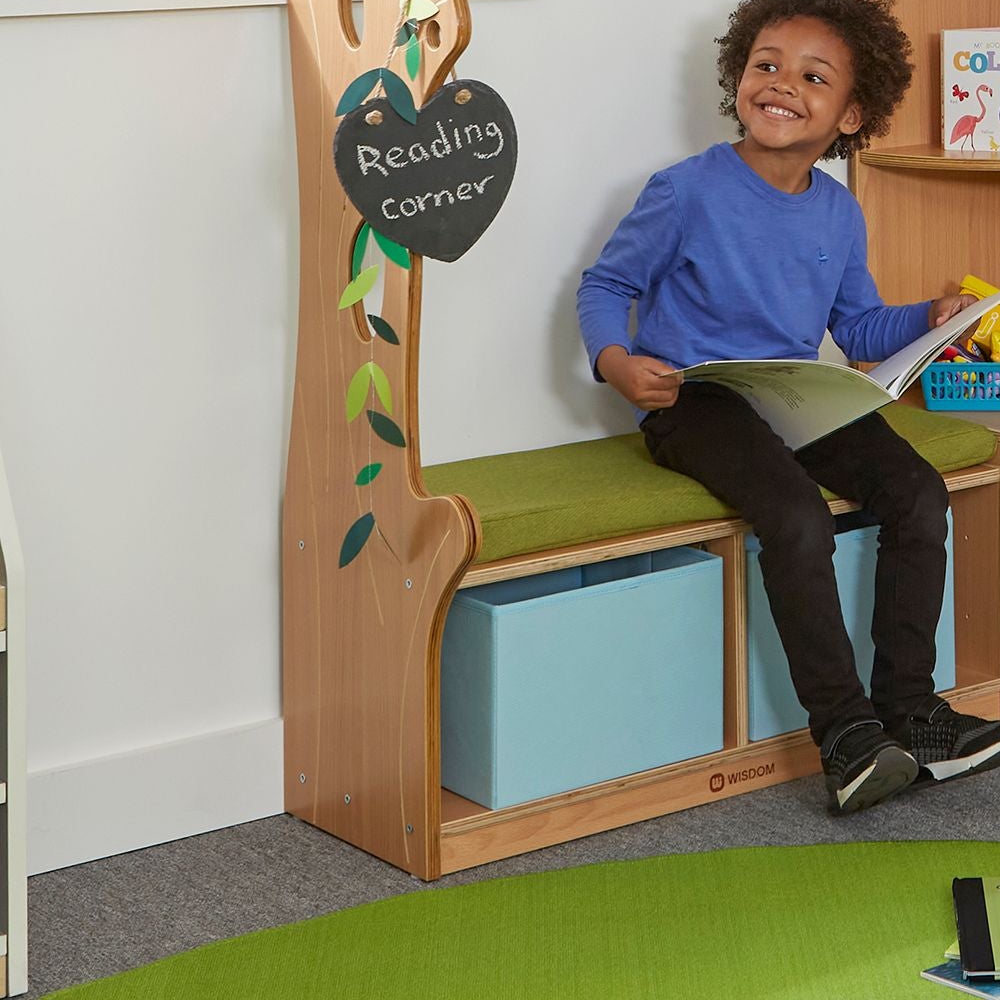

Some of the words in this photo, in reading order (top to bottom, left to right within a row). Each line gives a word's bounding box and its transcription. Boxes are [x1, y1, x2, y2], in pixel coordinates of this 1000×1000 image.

[357, 119, 504, 177] Reading
[381, 175, 495, 220] corner
[727, 763, 776, 784] WISDOM
